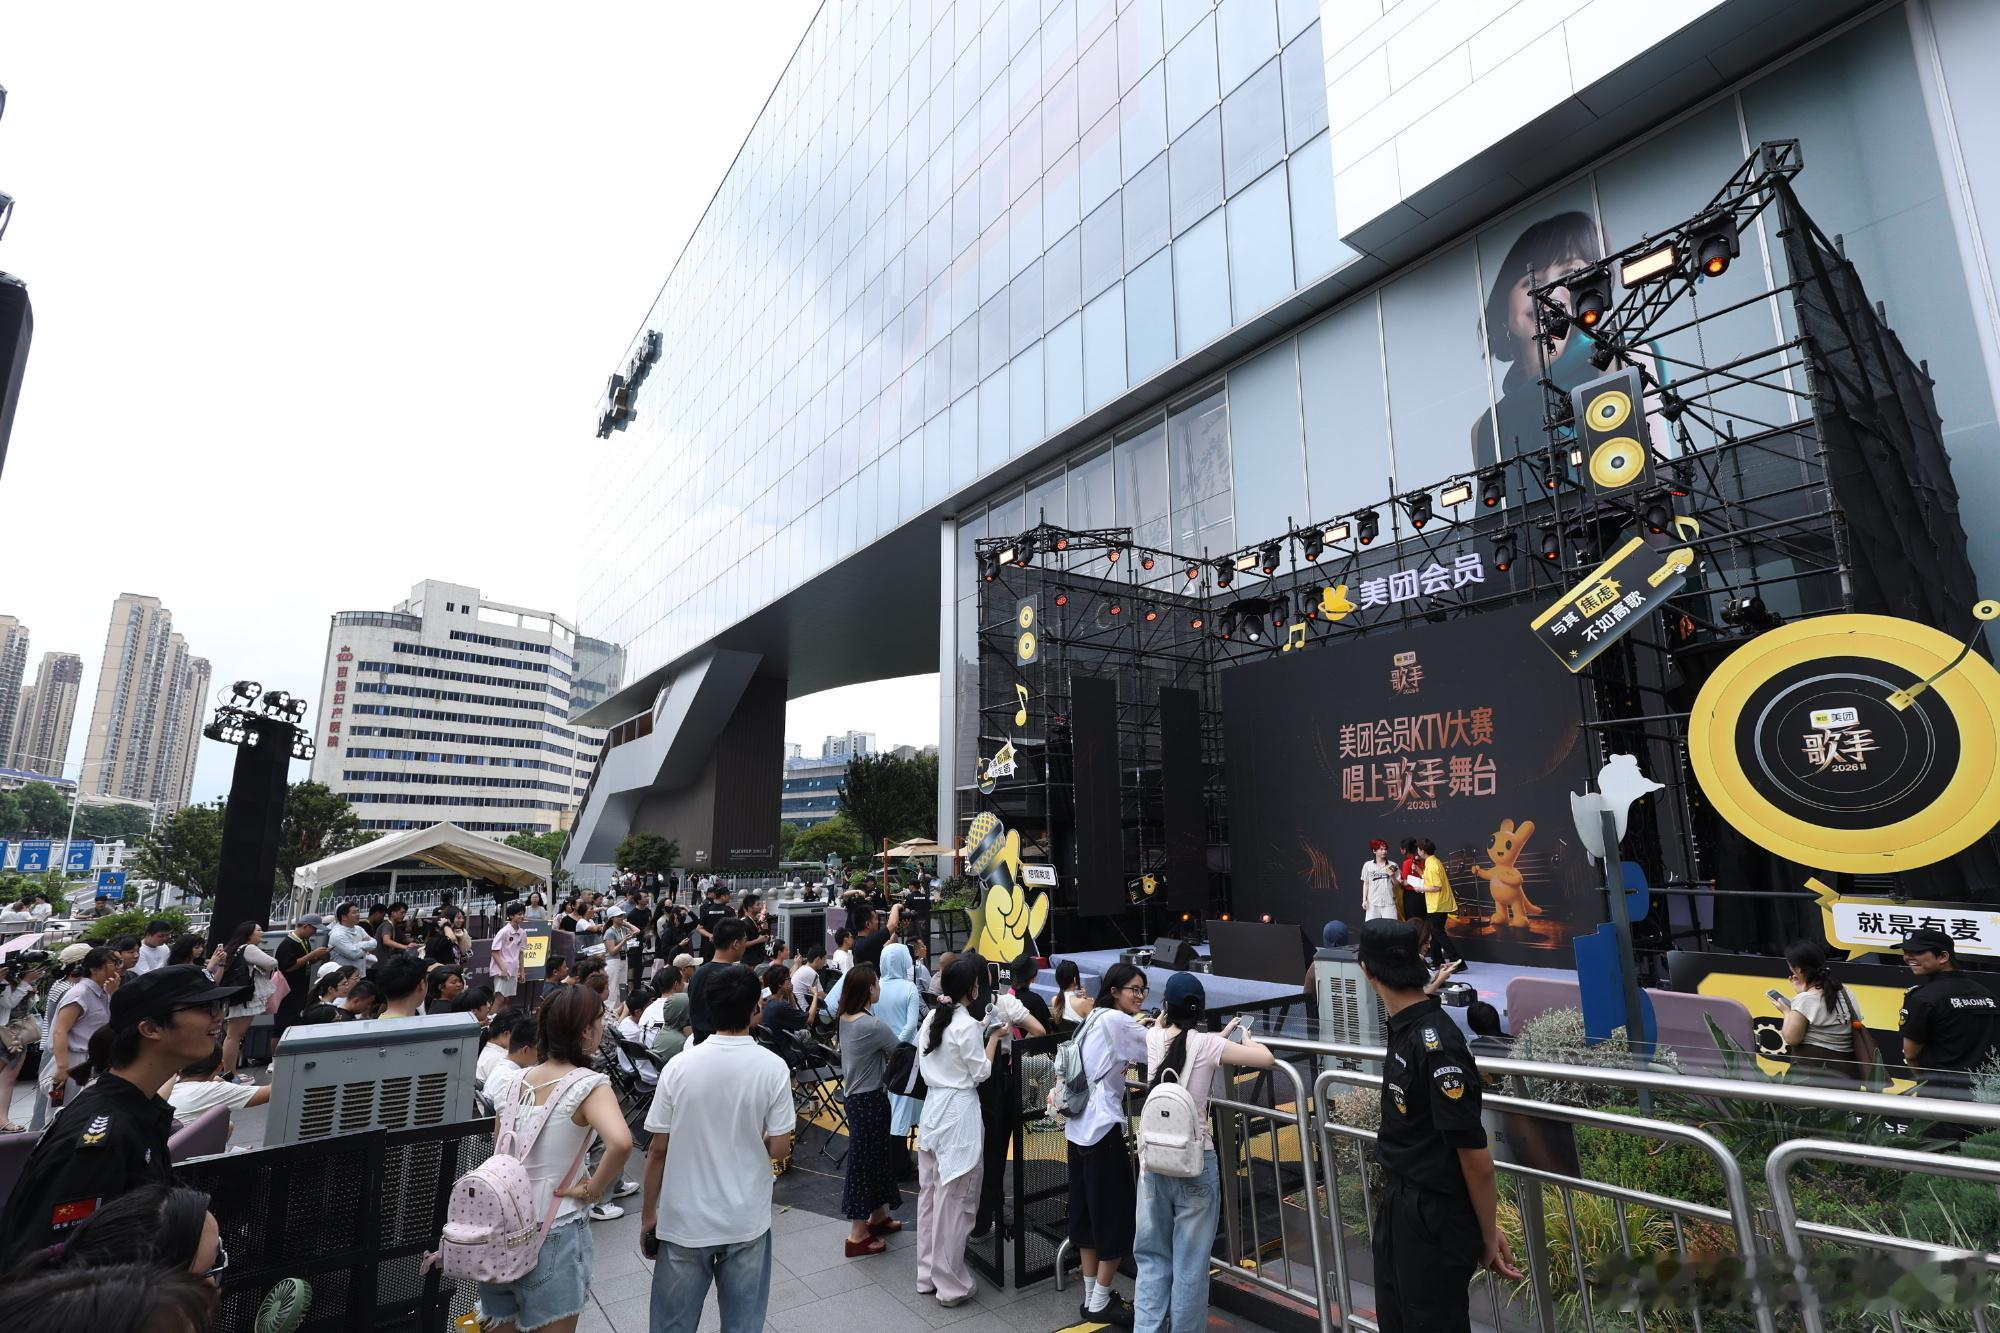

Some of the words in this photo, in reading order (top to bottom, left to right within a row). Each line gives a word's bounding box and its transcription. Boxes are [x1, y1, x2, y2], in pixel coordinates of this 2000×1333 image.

[1359, 552, 1485, 611] 美团会员
[1581, 590, 1647, 642] 不如高歌
[1390, 665, 1425, 692] 歌手
[1339, 706, 1494, 759] 美团会员KTV大赛
[1832, 712, 1854, 722] 美团
[1801, 729, 1881, 769] 歌手
[1832, 763, 1859, 772] 2026
[1407, 801, 1430, 810] 2026
